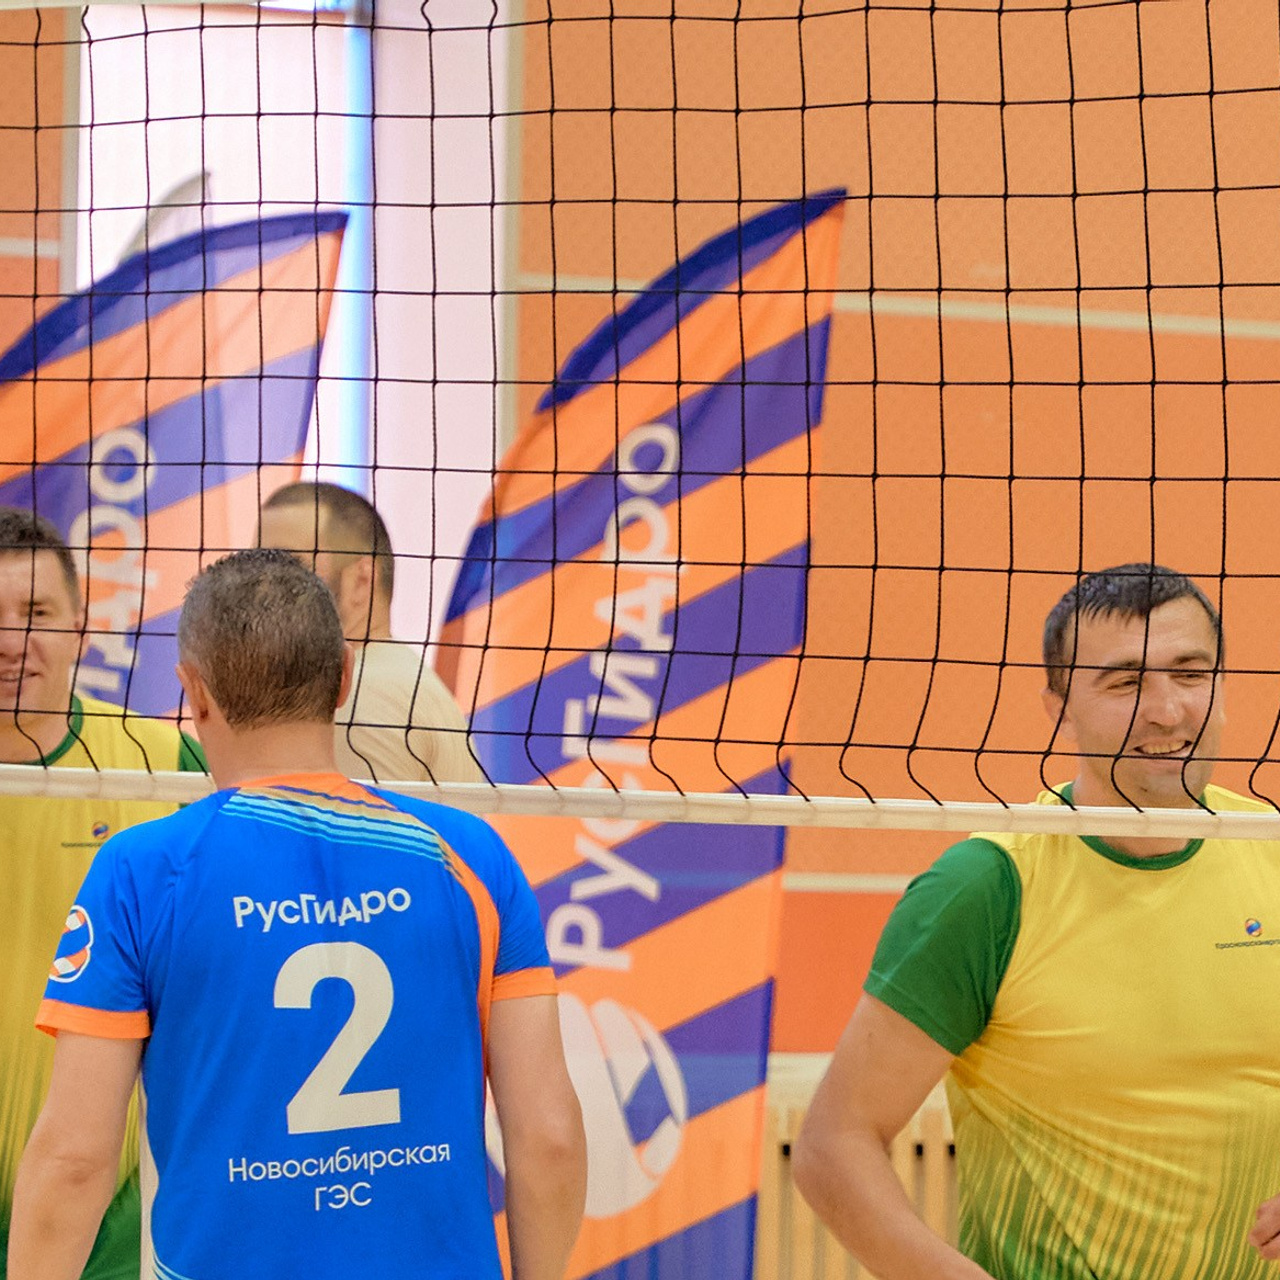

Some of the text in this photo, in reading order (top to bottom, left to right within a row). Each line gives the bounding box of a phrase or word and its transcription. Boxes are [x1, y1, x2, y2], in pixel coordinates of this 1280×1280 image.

[233, 888, 411, 932] РусГидро
[273, 941, 400, 1134] 2
[228, 1144, 450, 1182] Новосибирская
[314, 1182, 372, 1211] ГЭС
